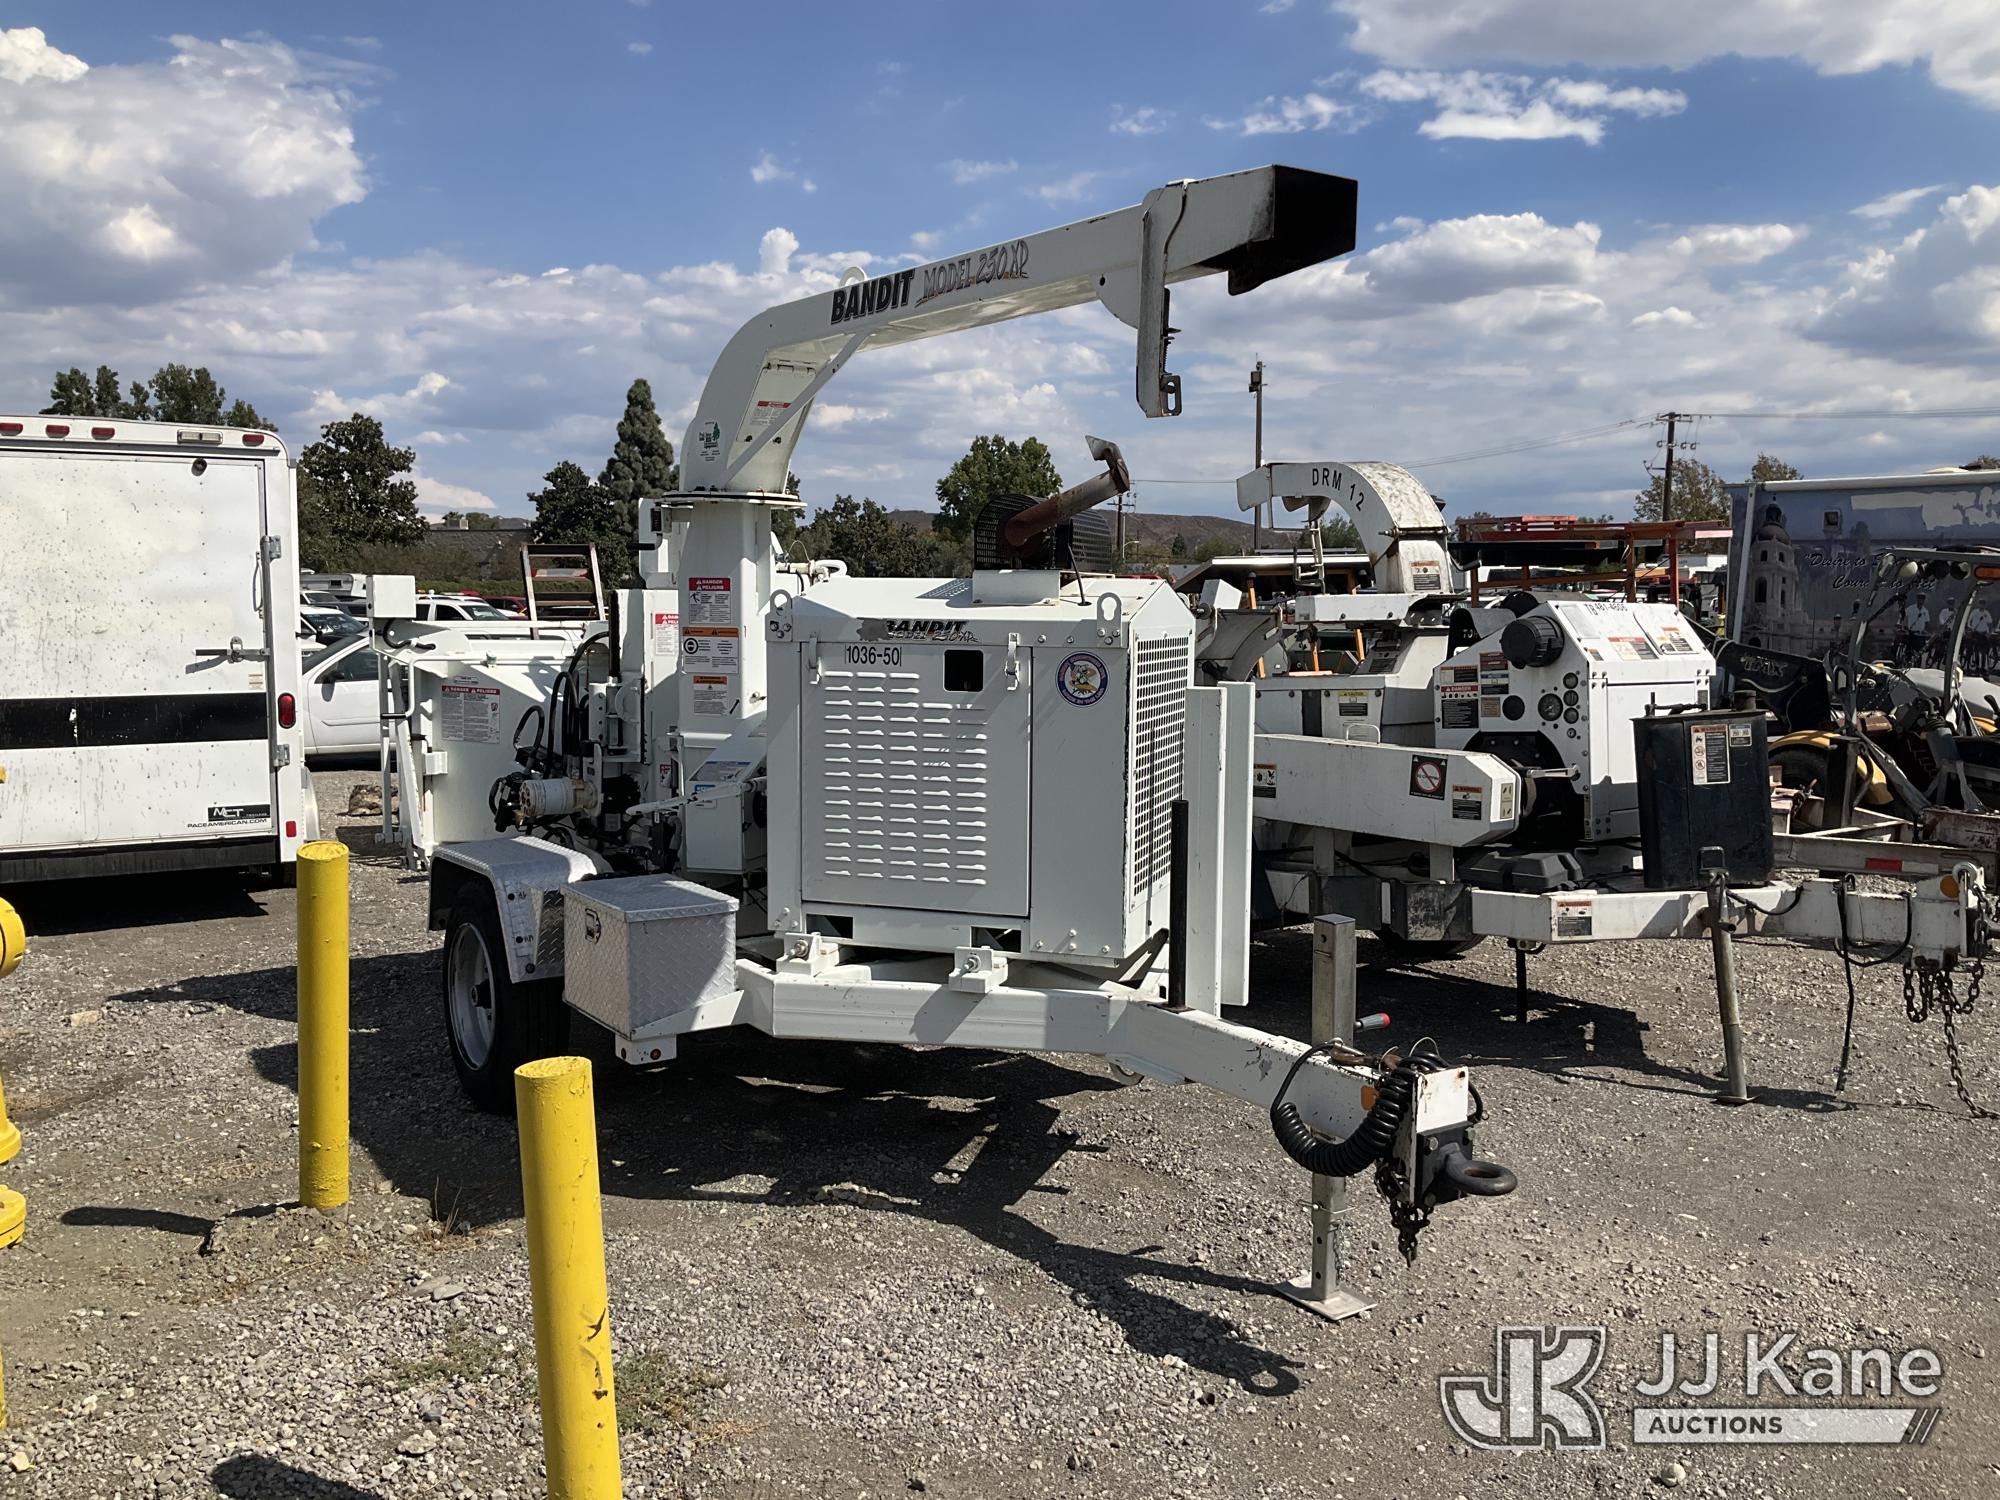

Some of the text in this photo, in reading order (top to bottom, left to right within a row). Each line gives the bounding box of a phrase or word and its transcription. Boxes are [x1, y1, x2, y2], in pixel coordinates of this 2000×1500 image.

[831, 268, 915, 325] BANDIT
[923, 258, 971, 299] MODEL
[1312, 467, 1364, 511] DRM 12
[1854, 557, 1867, 568] to
[846, 645, 900, 666] 1036-50
[187, 818, 268, 829] PACEAMERICAN.COM
